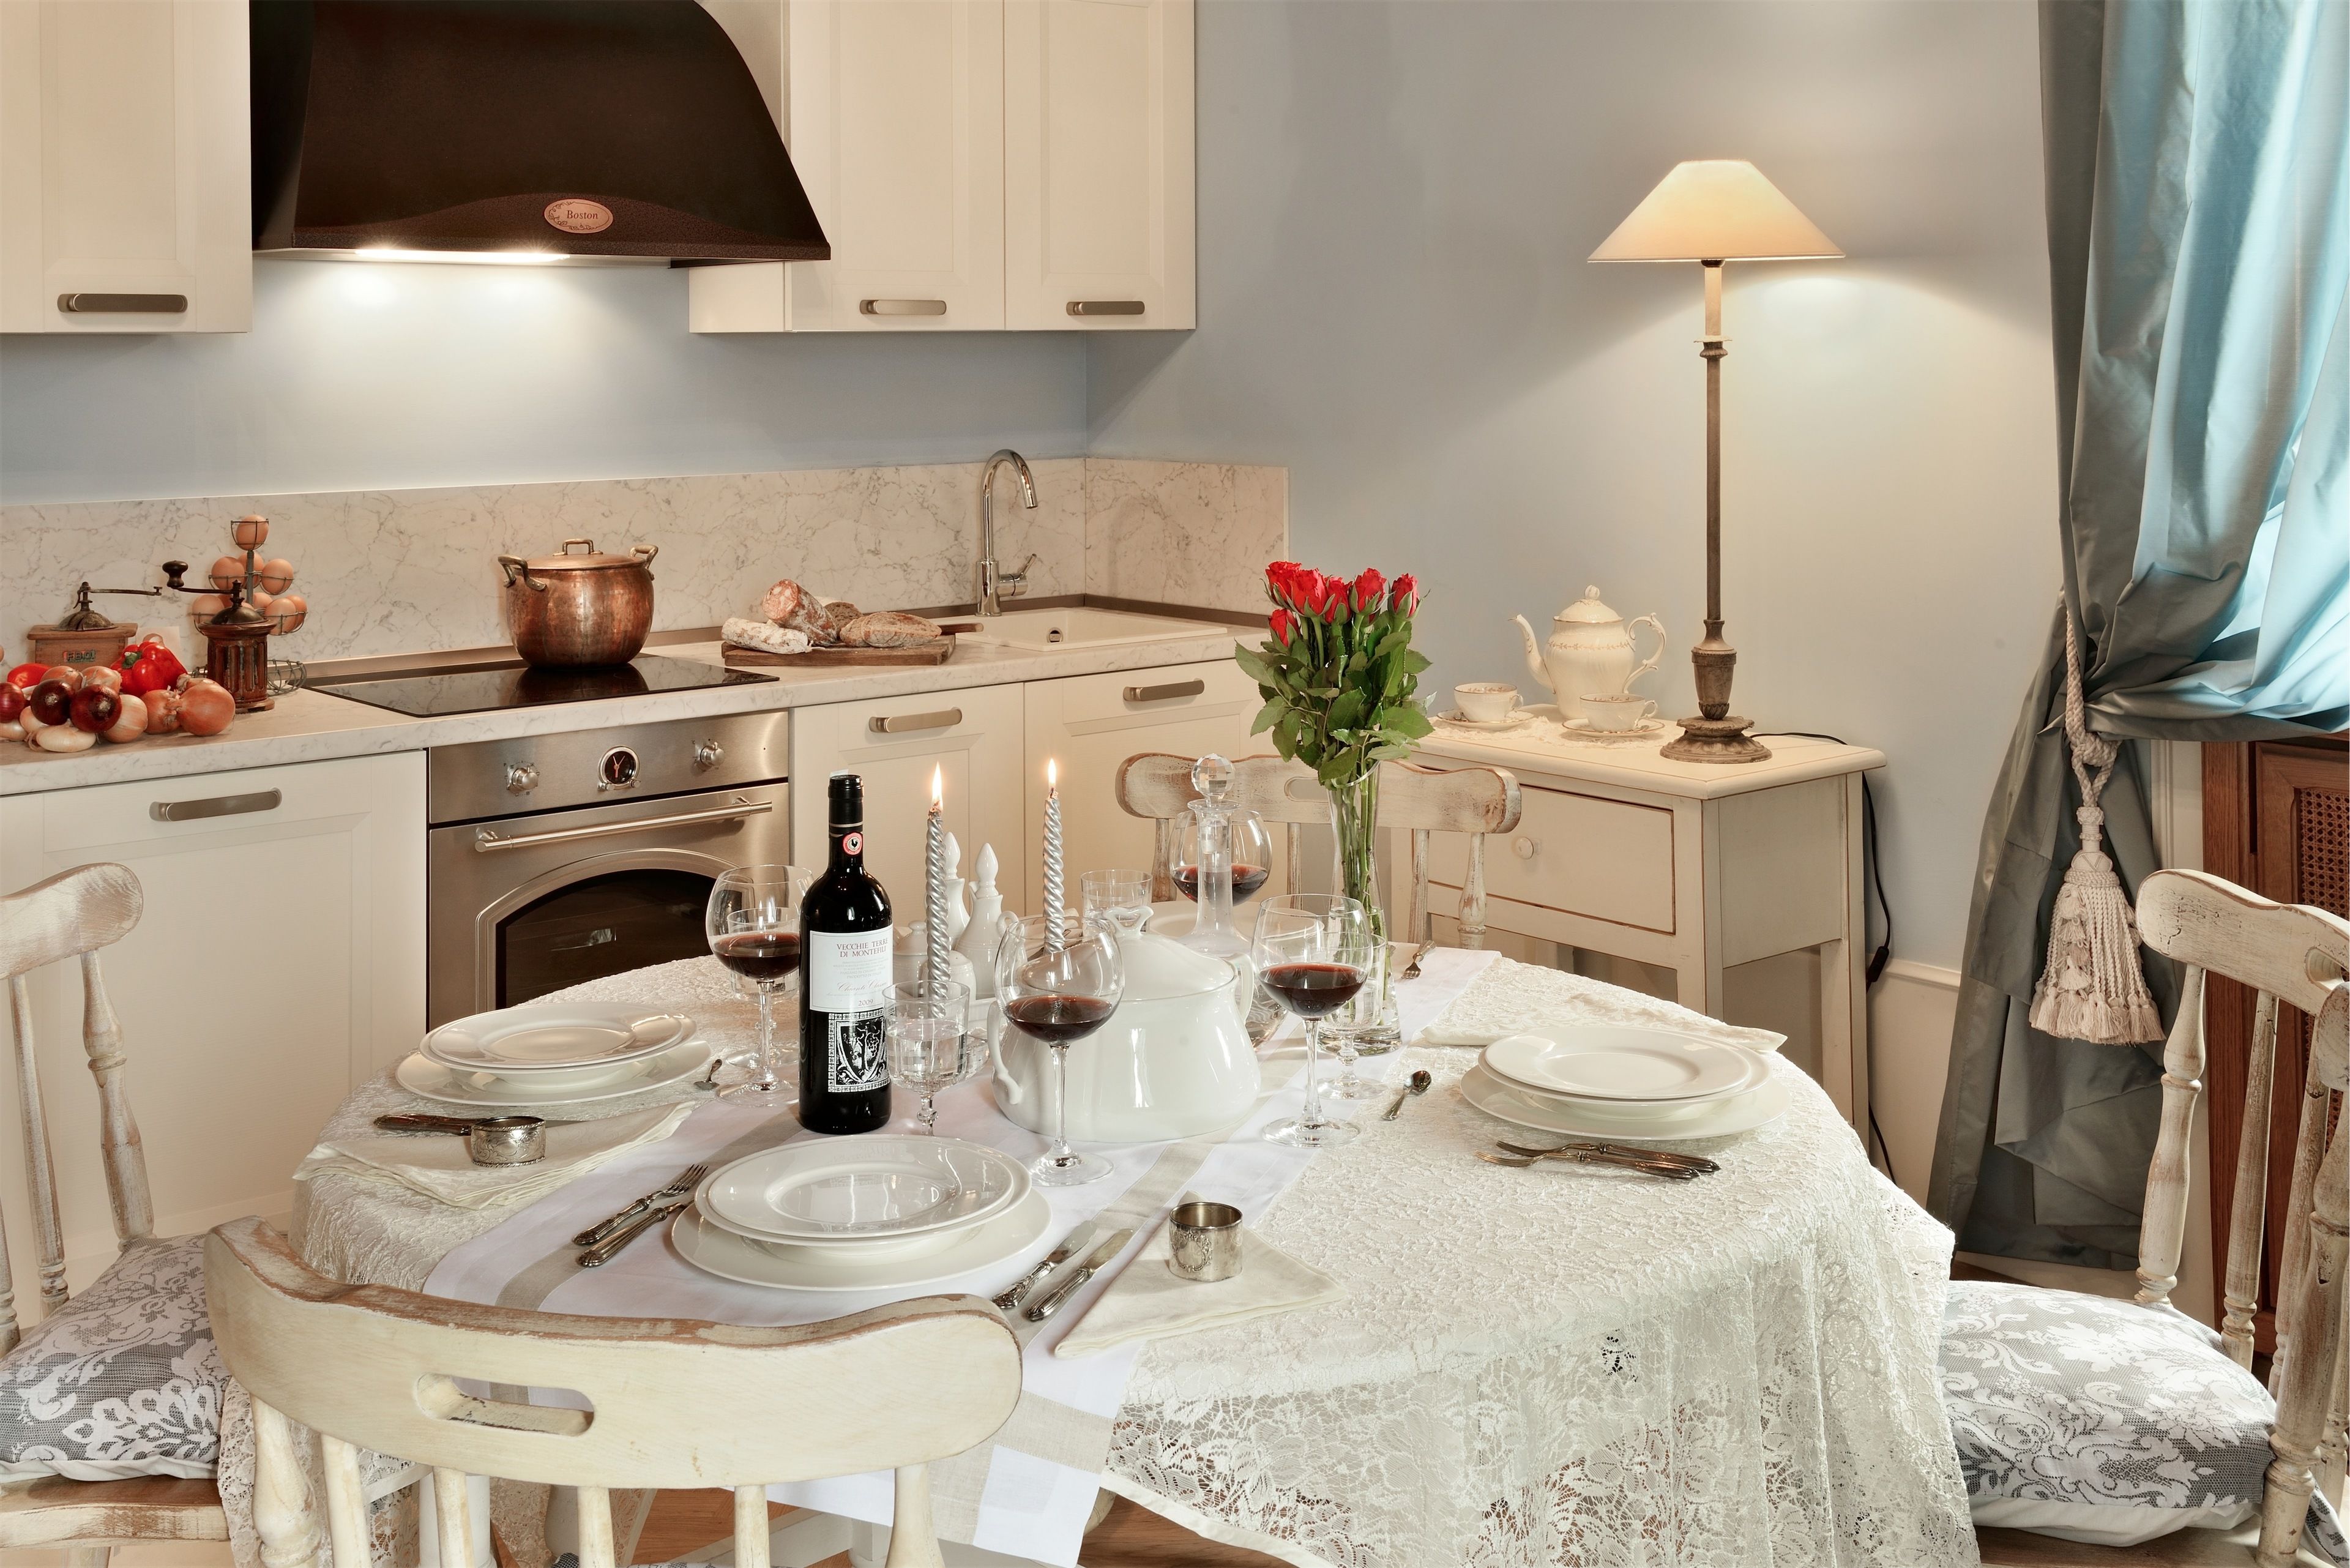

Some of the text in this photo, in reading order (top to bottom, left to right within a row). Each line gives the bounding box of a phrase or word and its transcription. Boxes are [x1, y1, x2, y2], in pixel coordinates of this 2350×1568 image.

[567, 210, 599, 220] Boston
[871, 938, 888, 947] TERRE
[852, 946, 886, 957] MONTEFILI
